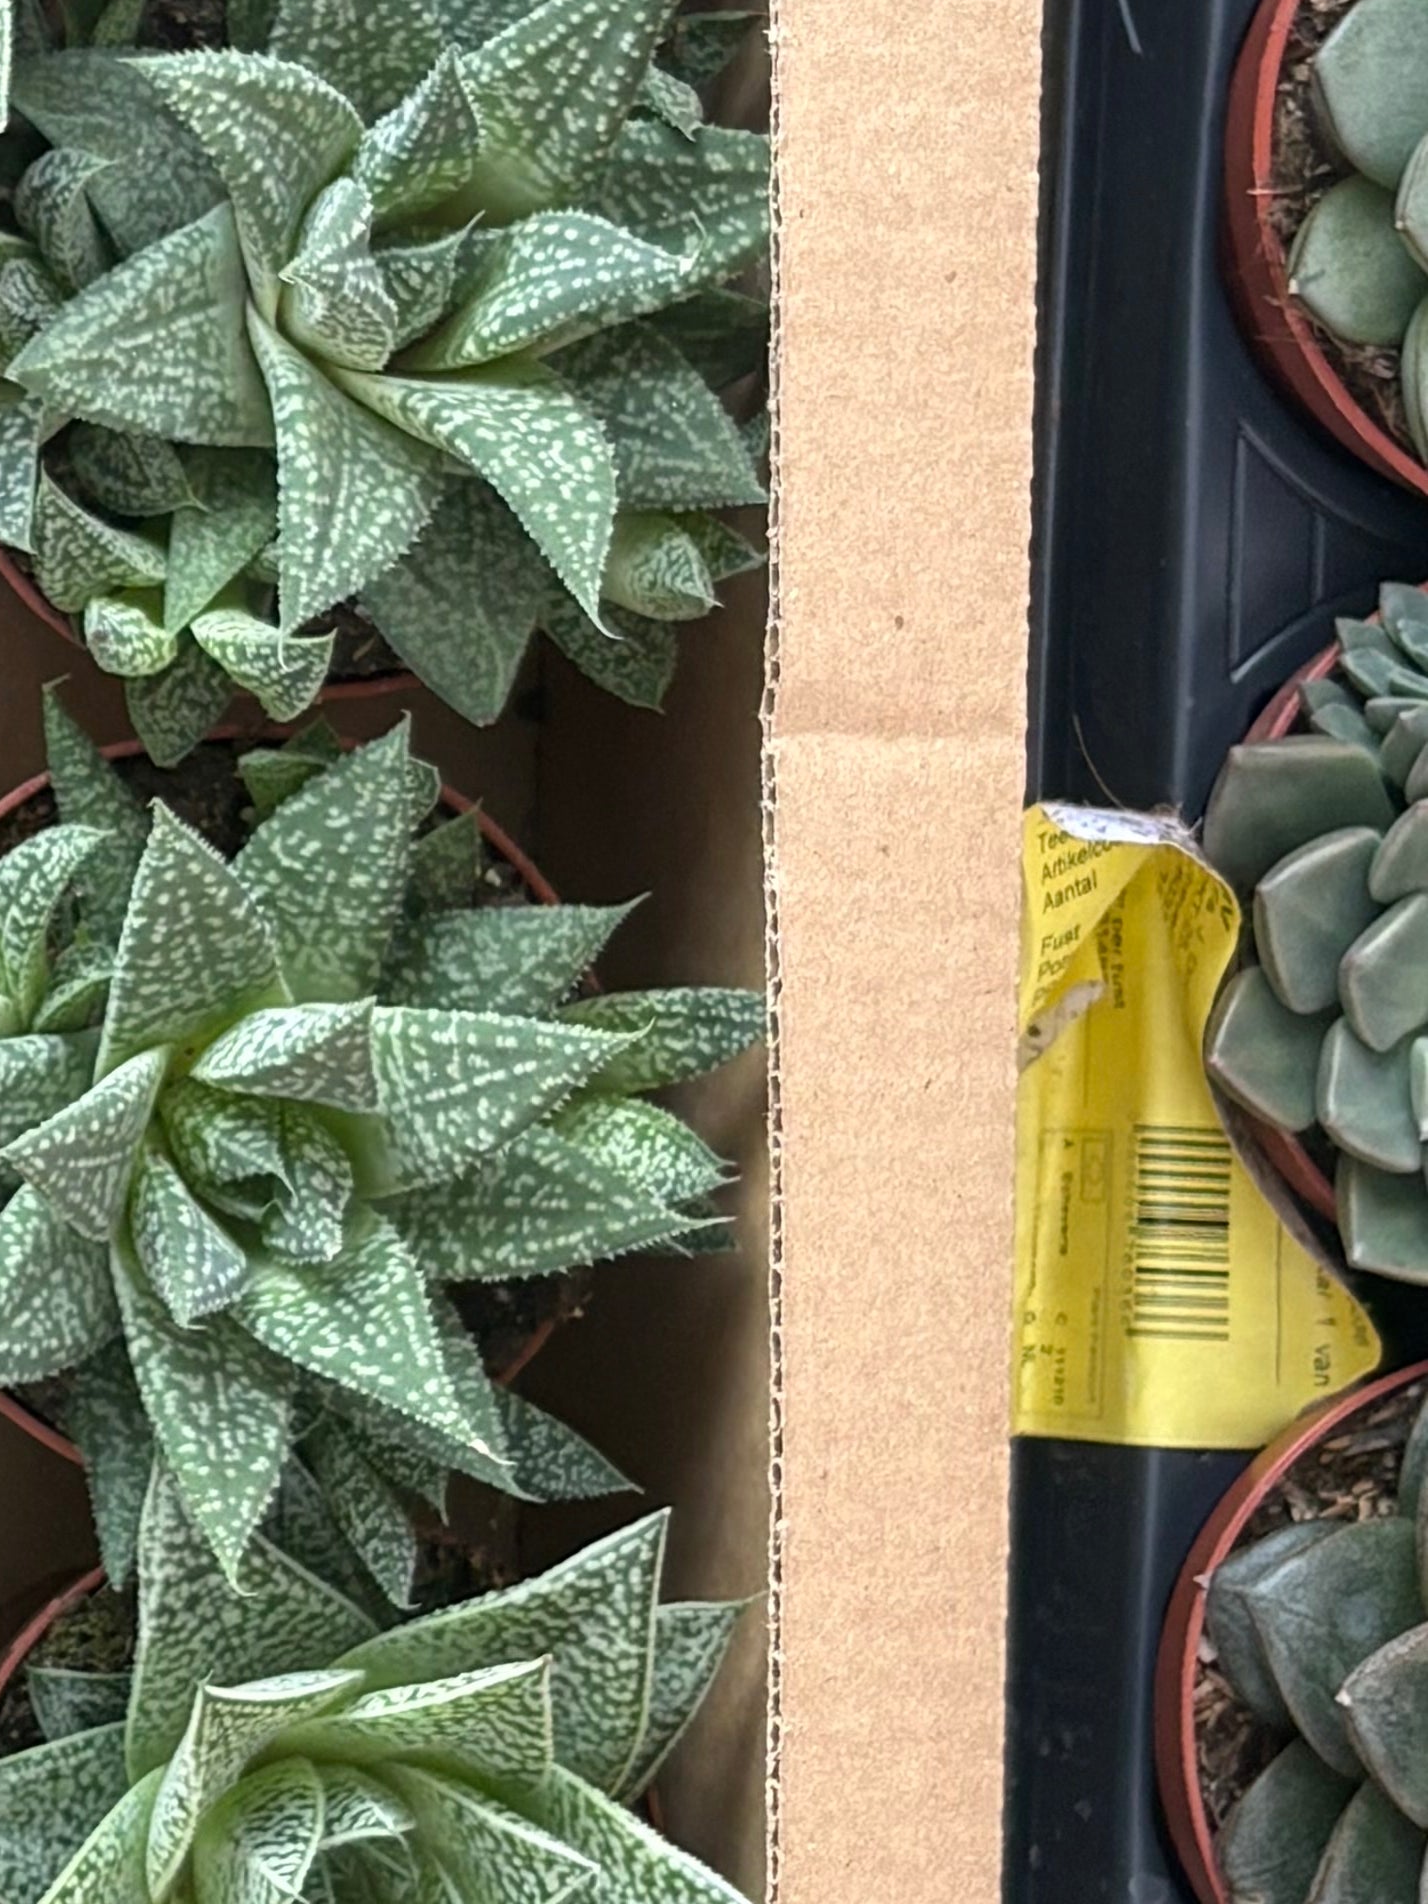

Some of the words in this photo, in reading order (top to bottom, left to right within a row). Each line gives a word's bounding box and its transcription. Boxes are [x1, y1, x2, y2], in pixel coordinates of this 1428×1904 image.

[1042, 867, 1097, 915] Aantal
[1040, 924, 1081, 957] Fust
[1313, 1342, 1331, 1387] van
